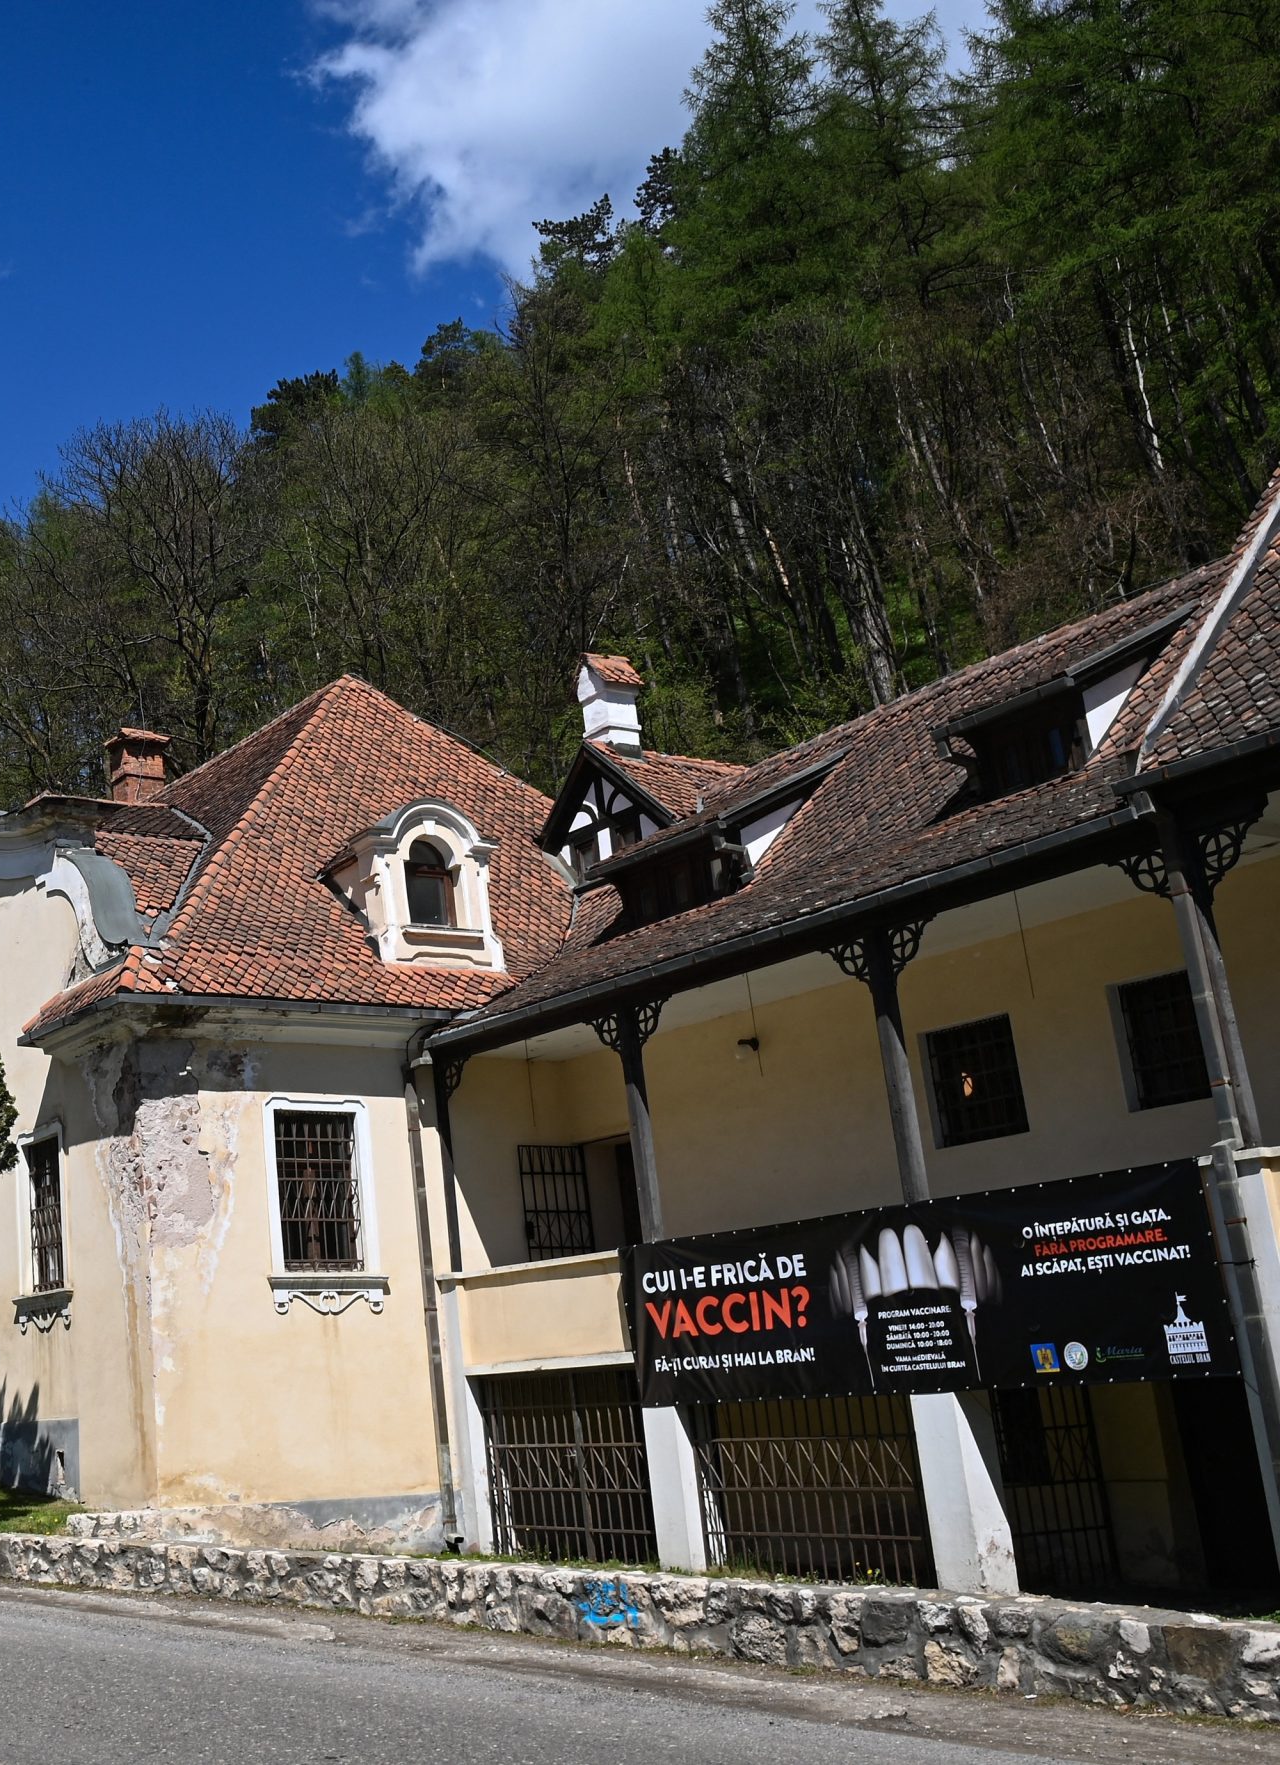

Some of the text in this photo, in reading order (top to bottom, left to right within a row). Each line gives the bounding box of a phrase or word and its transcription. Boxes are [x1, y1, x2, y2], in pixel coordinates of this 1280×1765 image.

[1022, 1226, 1033, 1239] O
[1034, 1212, 1115, 1241] ÎNȚEPĂTURĂ
[1117, 1213, 1129, 1233] ȘI
[1034, 1228, 1168, 1257] FĂRĂ PROGRAMARE.
[642, 1252, 807, 1294] CUI I-E FRICĂ DE
[1020, 1244, 1192, 1278] AI SCĂPAT, EȘTI VACCINAT!
[645, 1285, 810, 1340] VACCIN?
[878, 1309, 911, 1319] PROGRAM
[886, 1339, 916, 1350] DUMINICĂ
[912, 1351, 946, 1361] MEDIEVALĂ
[1170, 1352, 1212, 1365] CASTELUL BRAN
[655, 1347, 816, 1377] FĂ-ȚI CURAJ ȘI HAI LA BRAN!
[881, 1360, 966, 1373] ÎN CURTEA CASTELULUI BRAN
